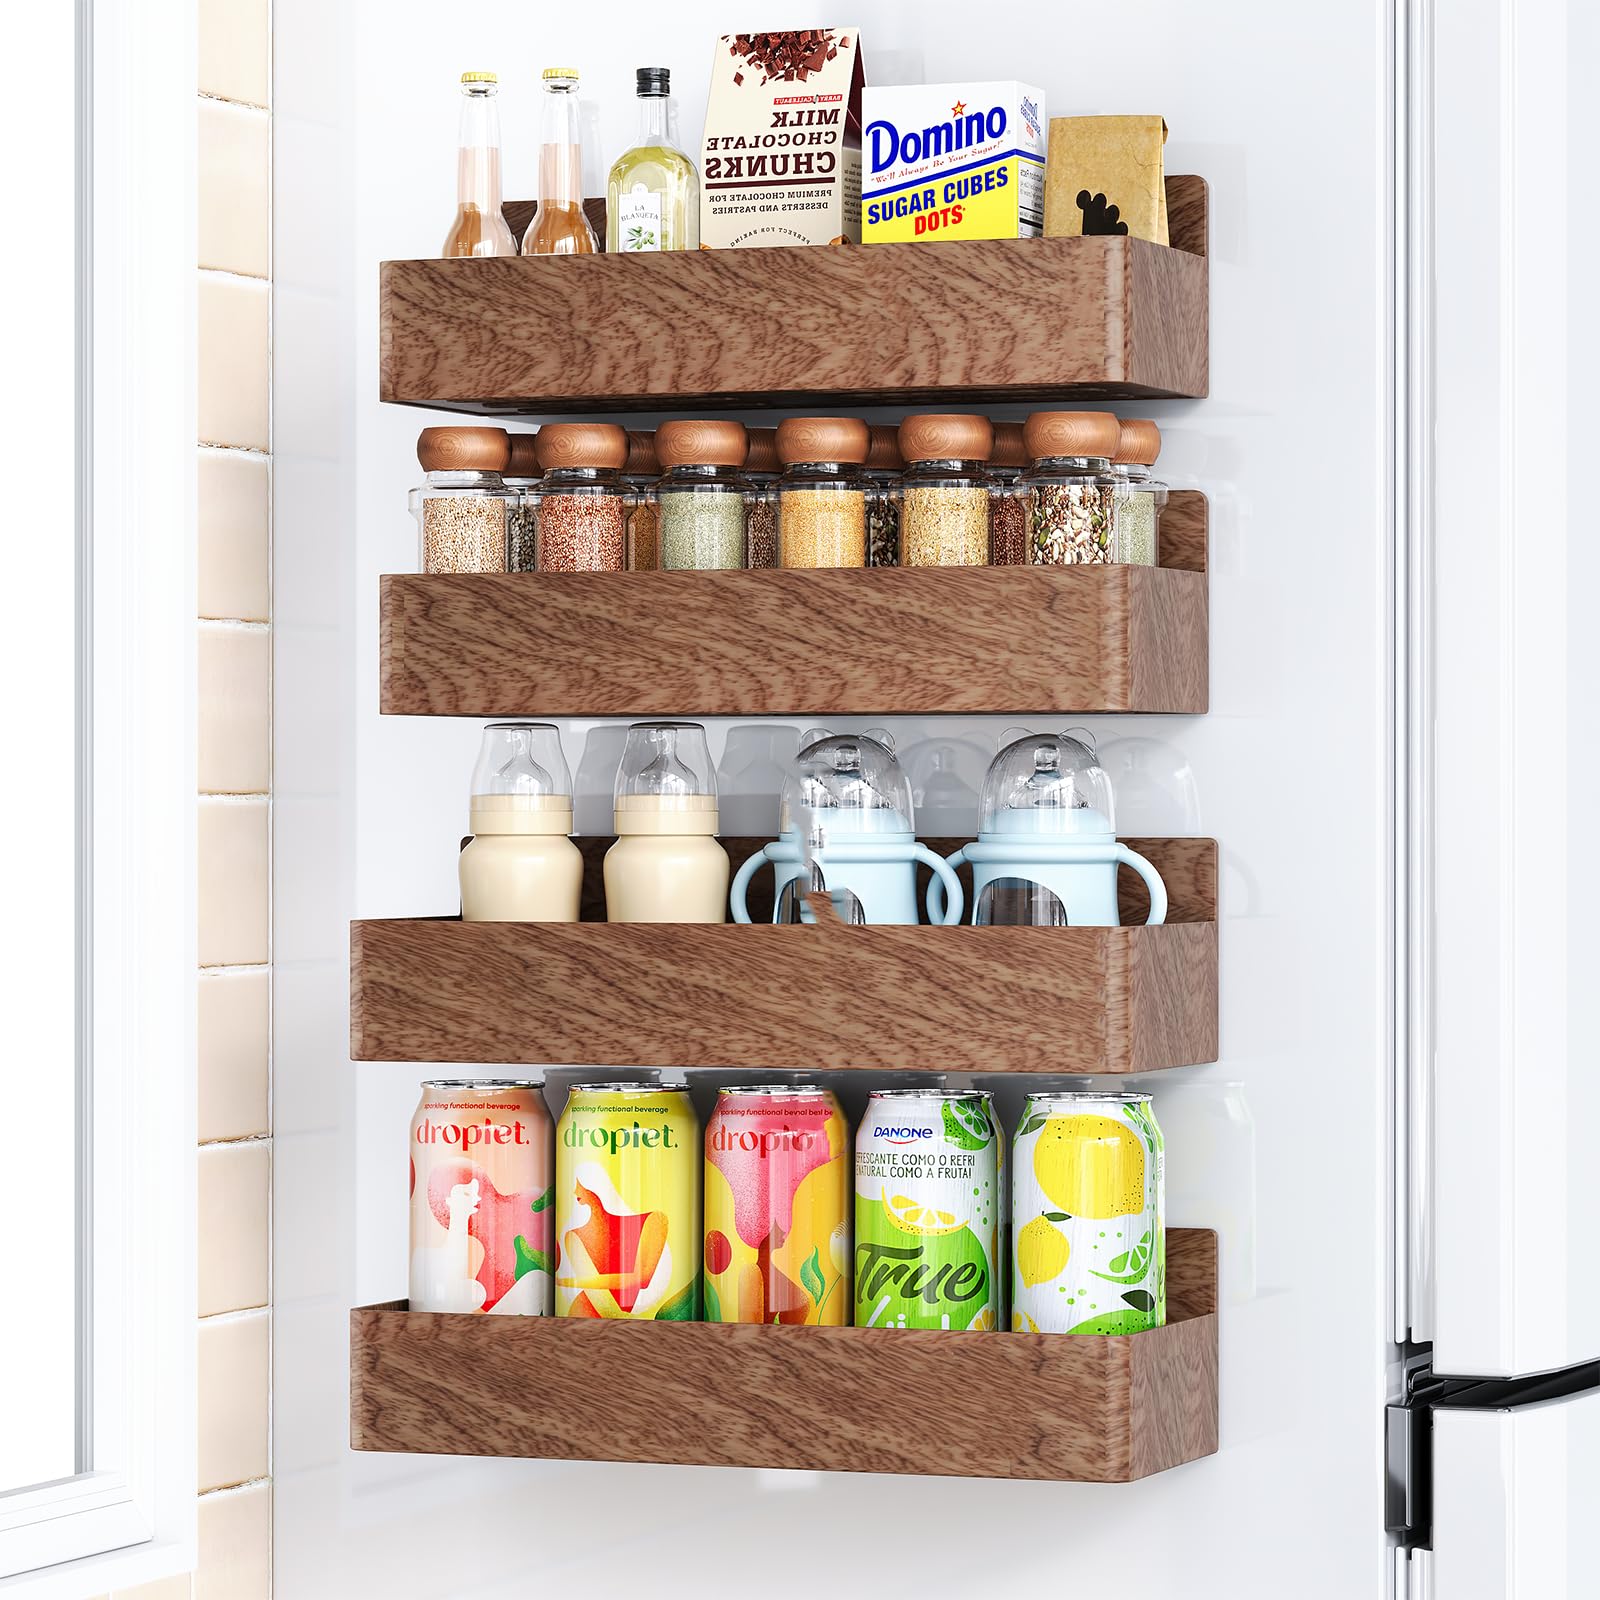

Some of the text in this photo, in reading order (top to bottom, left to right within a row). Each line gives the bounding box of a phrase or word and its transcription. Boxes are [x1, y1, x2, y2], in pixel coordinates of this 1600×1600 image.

[865, 103, 1007, 174] Domino
[898, 164, 929, 178] Always
[933, 159, 944, 168] Be
[948, 153, 968, 164] Your
[867, 188, 936, 225] SUGAR
[943, 166, 1009, 204] CUBES
[914, 204, 964, 236] DOTS
[449, 1102, 486, 1110] functional
[486, 1103, 521, 1112] beverage
[597, 1105, 633, 1113] functional
[634, 1105, 669, 1114] beverage
[746, 1108, 783, 1116] functional
[873, 1126, 934, 1139] DANONE
[901, 1153, 936, 1166] COMO
[938, 1154, 947, 1167] O
[950, 1155, 975, 1167] REFRI
[889, 1166, 923, 1179] COMO
[926, 1167, 934, 1178] A
[938, 1167, 972, 1179] FRUTA!
[856, 1242, 986, 1305] True
